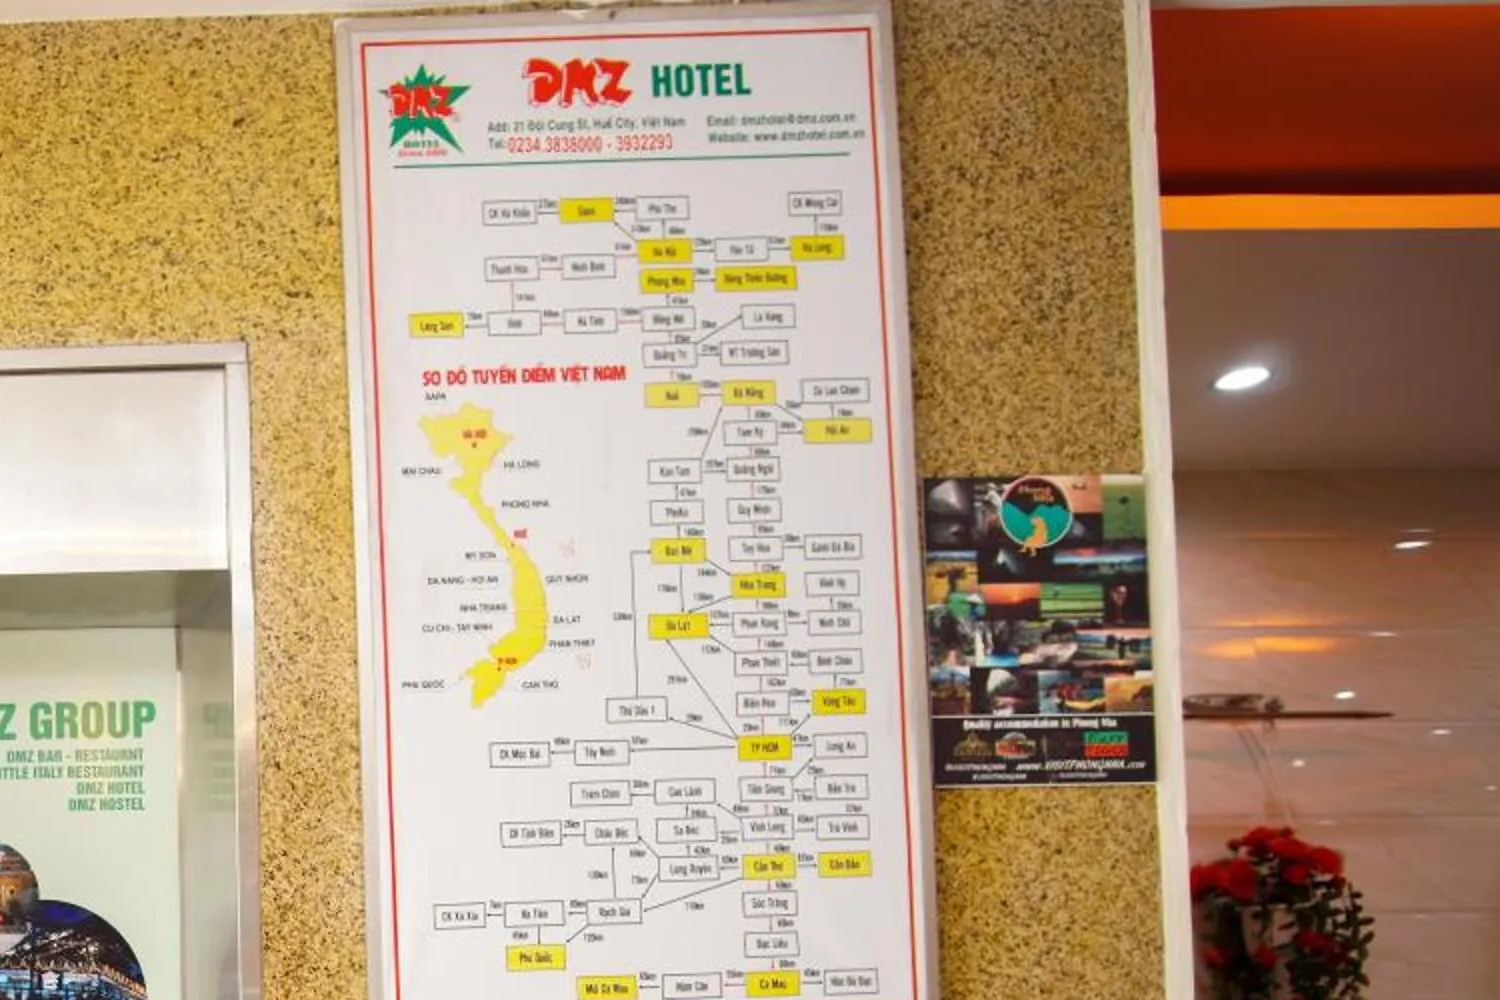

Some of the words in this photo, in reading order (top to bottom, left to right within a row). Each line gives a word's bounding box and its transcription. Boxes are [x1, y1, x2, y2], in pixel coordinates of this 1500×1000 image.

[522, 57, 633, 108] DMZ
[651, 64, 752, 97] HOTEL
[388, 81, 454, 118] DMZ
[593, 365, 627, 381] NAM
[28, 701, 157, 741] GROUP
[7, 751, 34, 763] DMZ
[38, 750, 62, 763] BAR
[33, 766, 63, 779] ITALY
[67, 765, 144, 778] RESTAURANT
[77, 782, 102, 795] DMZ
[107, 781, 145, 794] HOTEL
[68, 798, 96, 811] DMZ
[100, 798, 145, 810] HOSTEL
